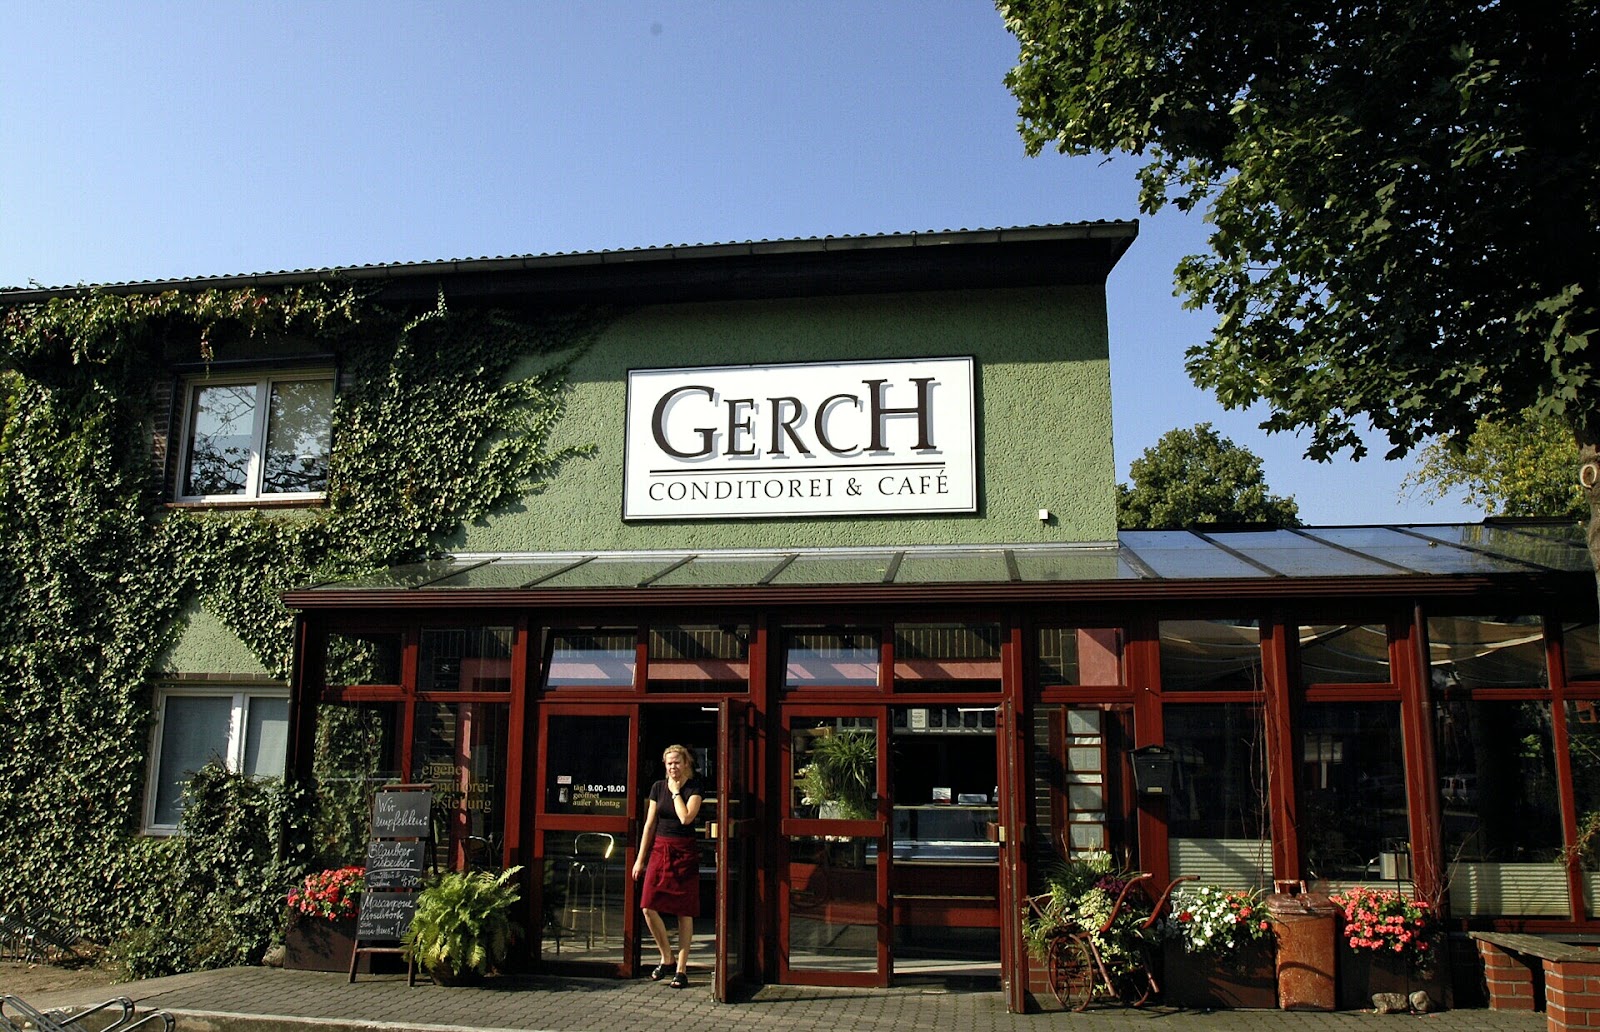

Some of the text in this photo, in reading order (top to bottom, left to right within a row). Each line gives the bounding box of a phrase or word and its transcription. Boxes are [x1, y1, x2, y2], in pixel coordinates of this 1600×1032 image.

[651, 376, 943, 464] GERCH
[648, 469, 949, 502] CONDITOREI & CAFÉ
[421, 765, 463, 778] eigene
[378, 796, 397, 813] Wir
[595, 800, 621, 809] Montag
